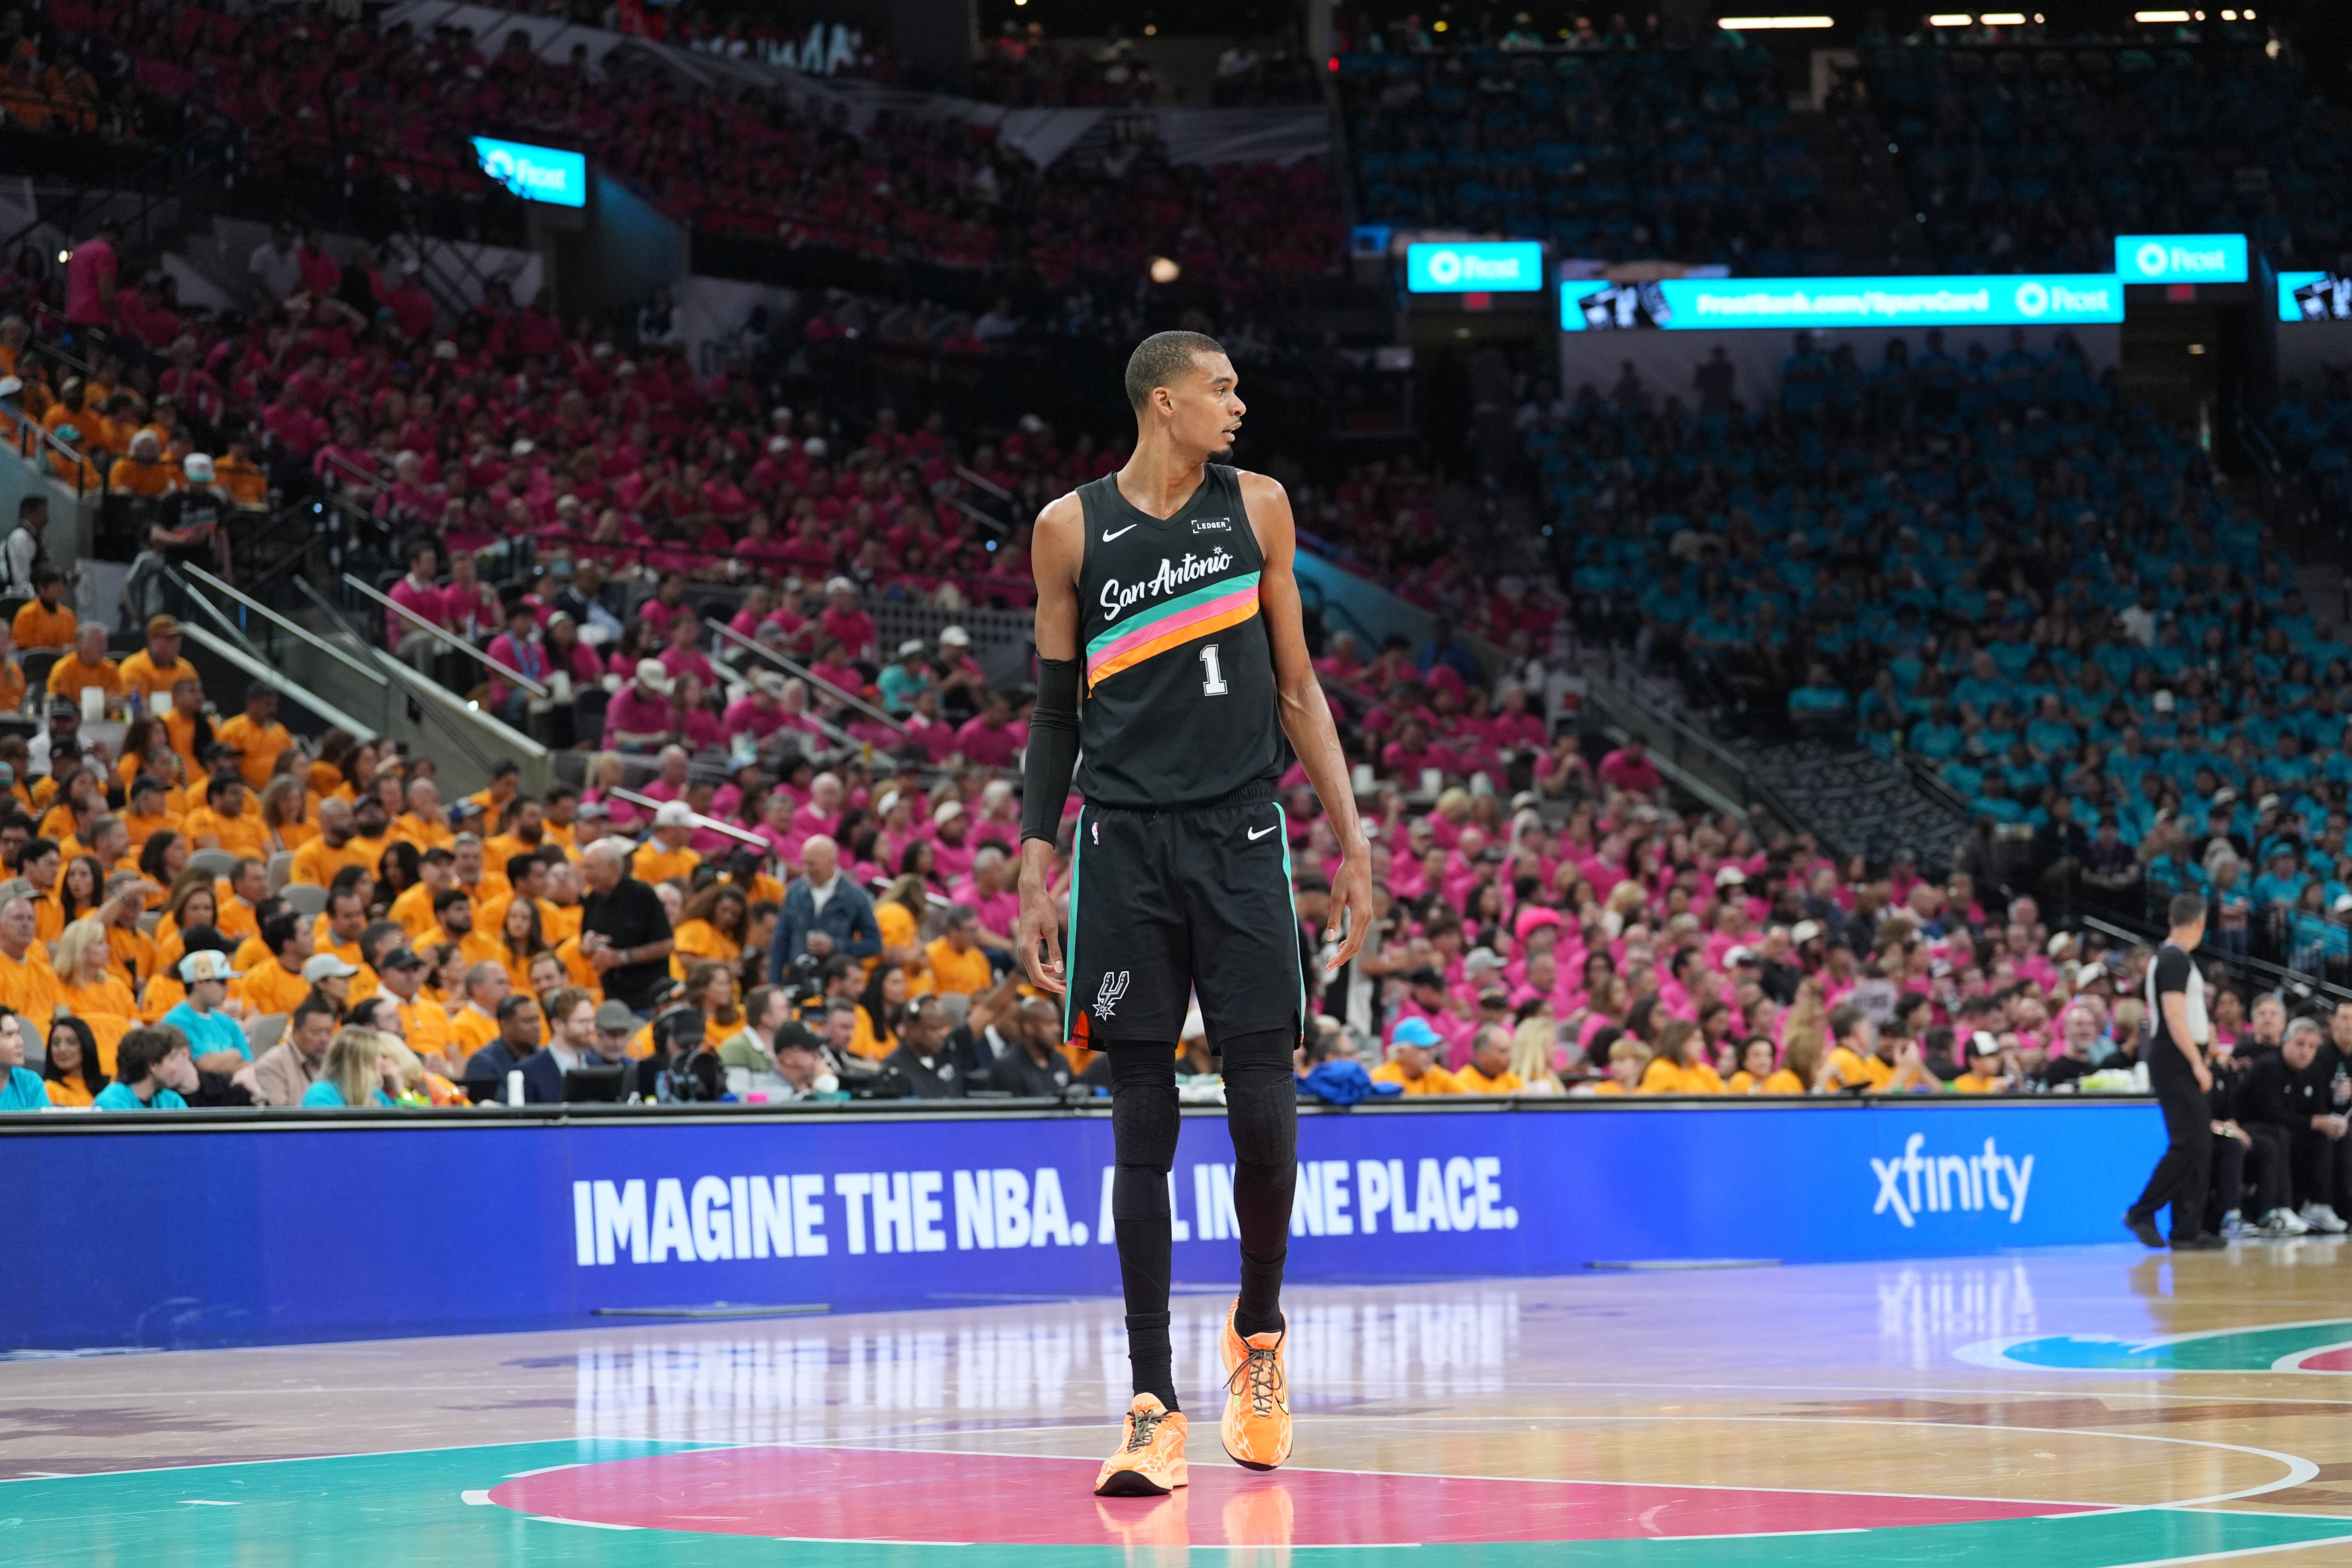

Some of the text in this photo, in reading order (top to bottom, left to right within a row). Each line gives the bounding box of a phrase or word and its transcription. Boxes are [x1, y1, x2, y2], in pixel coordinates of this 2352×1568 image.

[517, 158, 566, 190] Frost
[1463, 255, 1519, 279] Frost
[2170, 247, 2225, 271] Frost
[2050, 286, 2109, 312] Frost
[1197, 521, 1226, 530] LEDGER
[1100, 553, 1233, 621] San Antonio
[1199, 644, 1228, 696] 1
[1871, 1133, 2034, 1227] xfinity
[573, 1174, 828, 1265] IMAGINE
[834, 1172, 946, 1254] THE
[953, 1169, 1089, 1249] NBA.
[1290, 1161, 1353, 1236] NE
[1357, 1157, 1518, 1233] PLACE.
